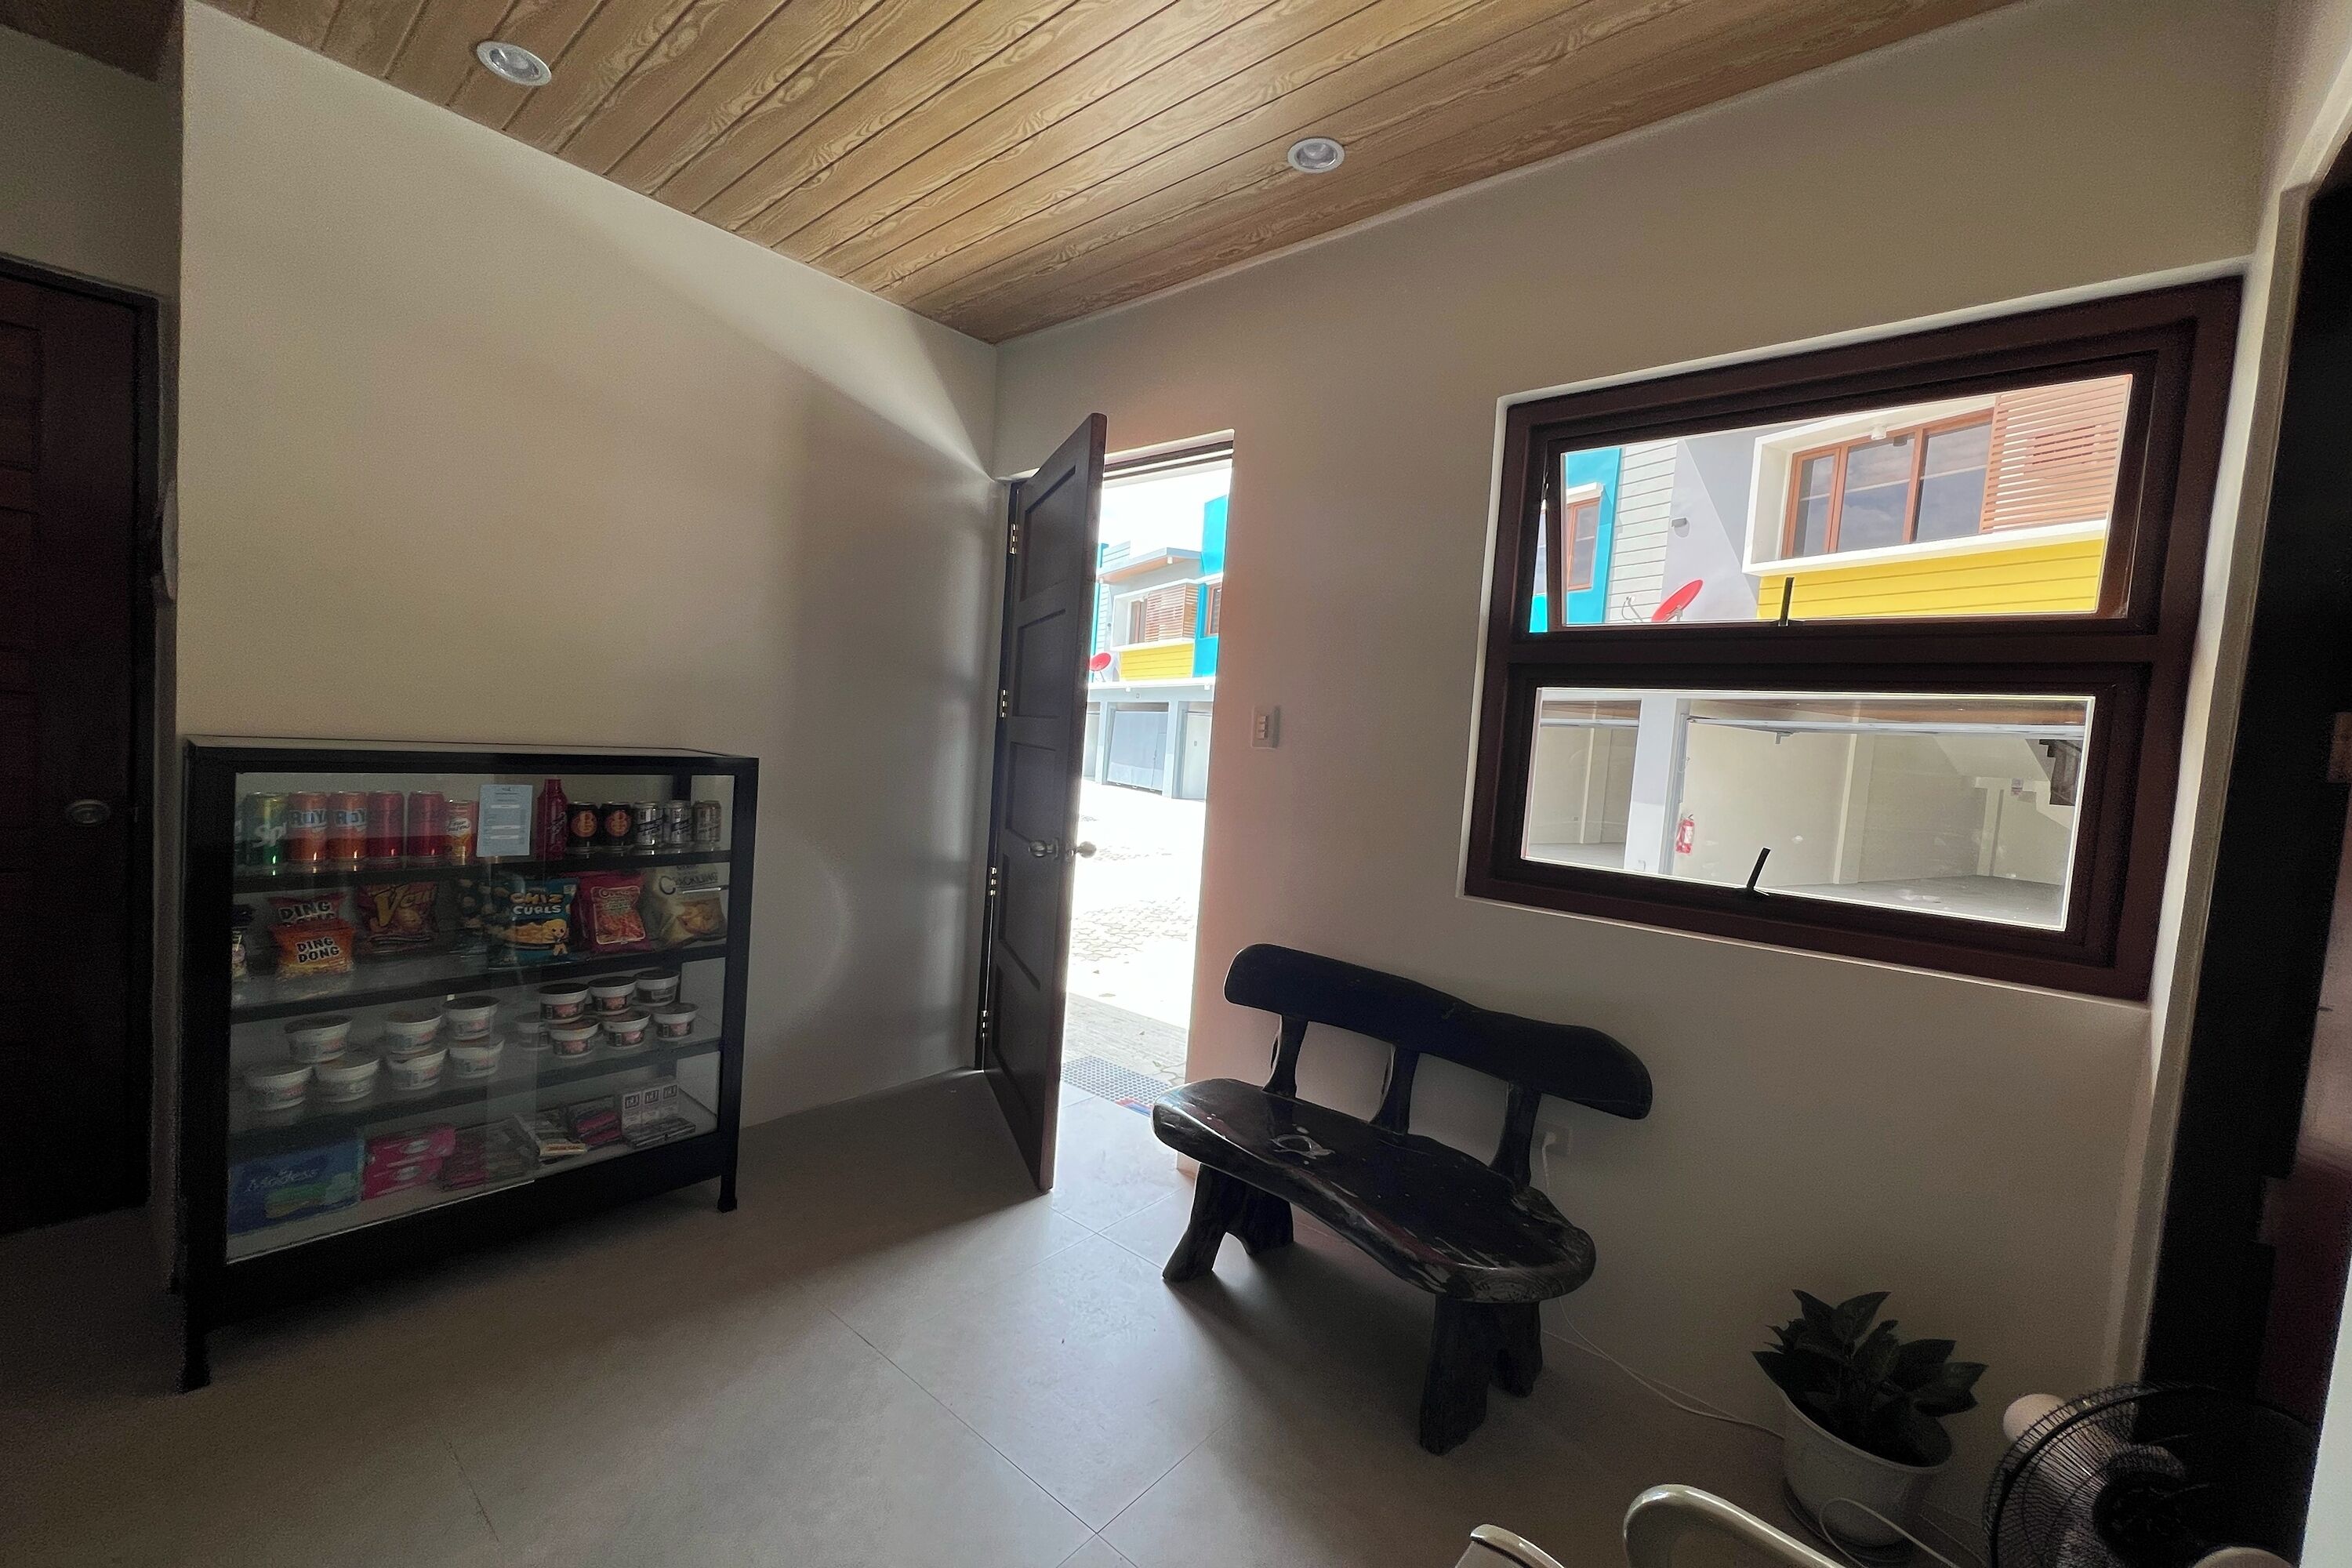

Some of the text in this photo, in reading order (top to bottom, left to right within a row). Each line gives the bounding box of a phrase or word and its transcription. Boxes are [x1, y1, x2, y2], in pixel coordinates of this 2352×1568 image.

[509, 892, 564, 905] CHIZ
[278, 901, 332, 920] DING
[511, 904, 563, 916] CURLS
[296, 936, 335, 952] DING
[297, 946, 340, 964] DONG
